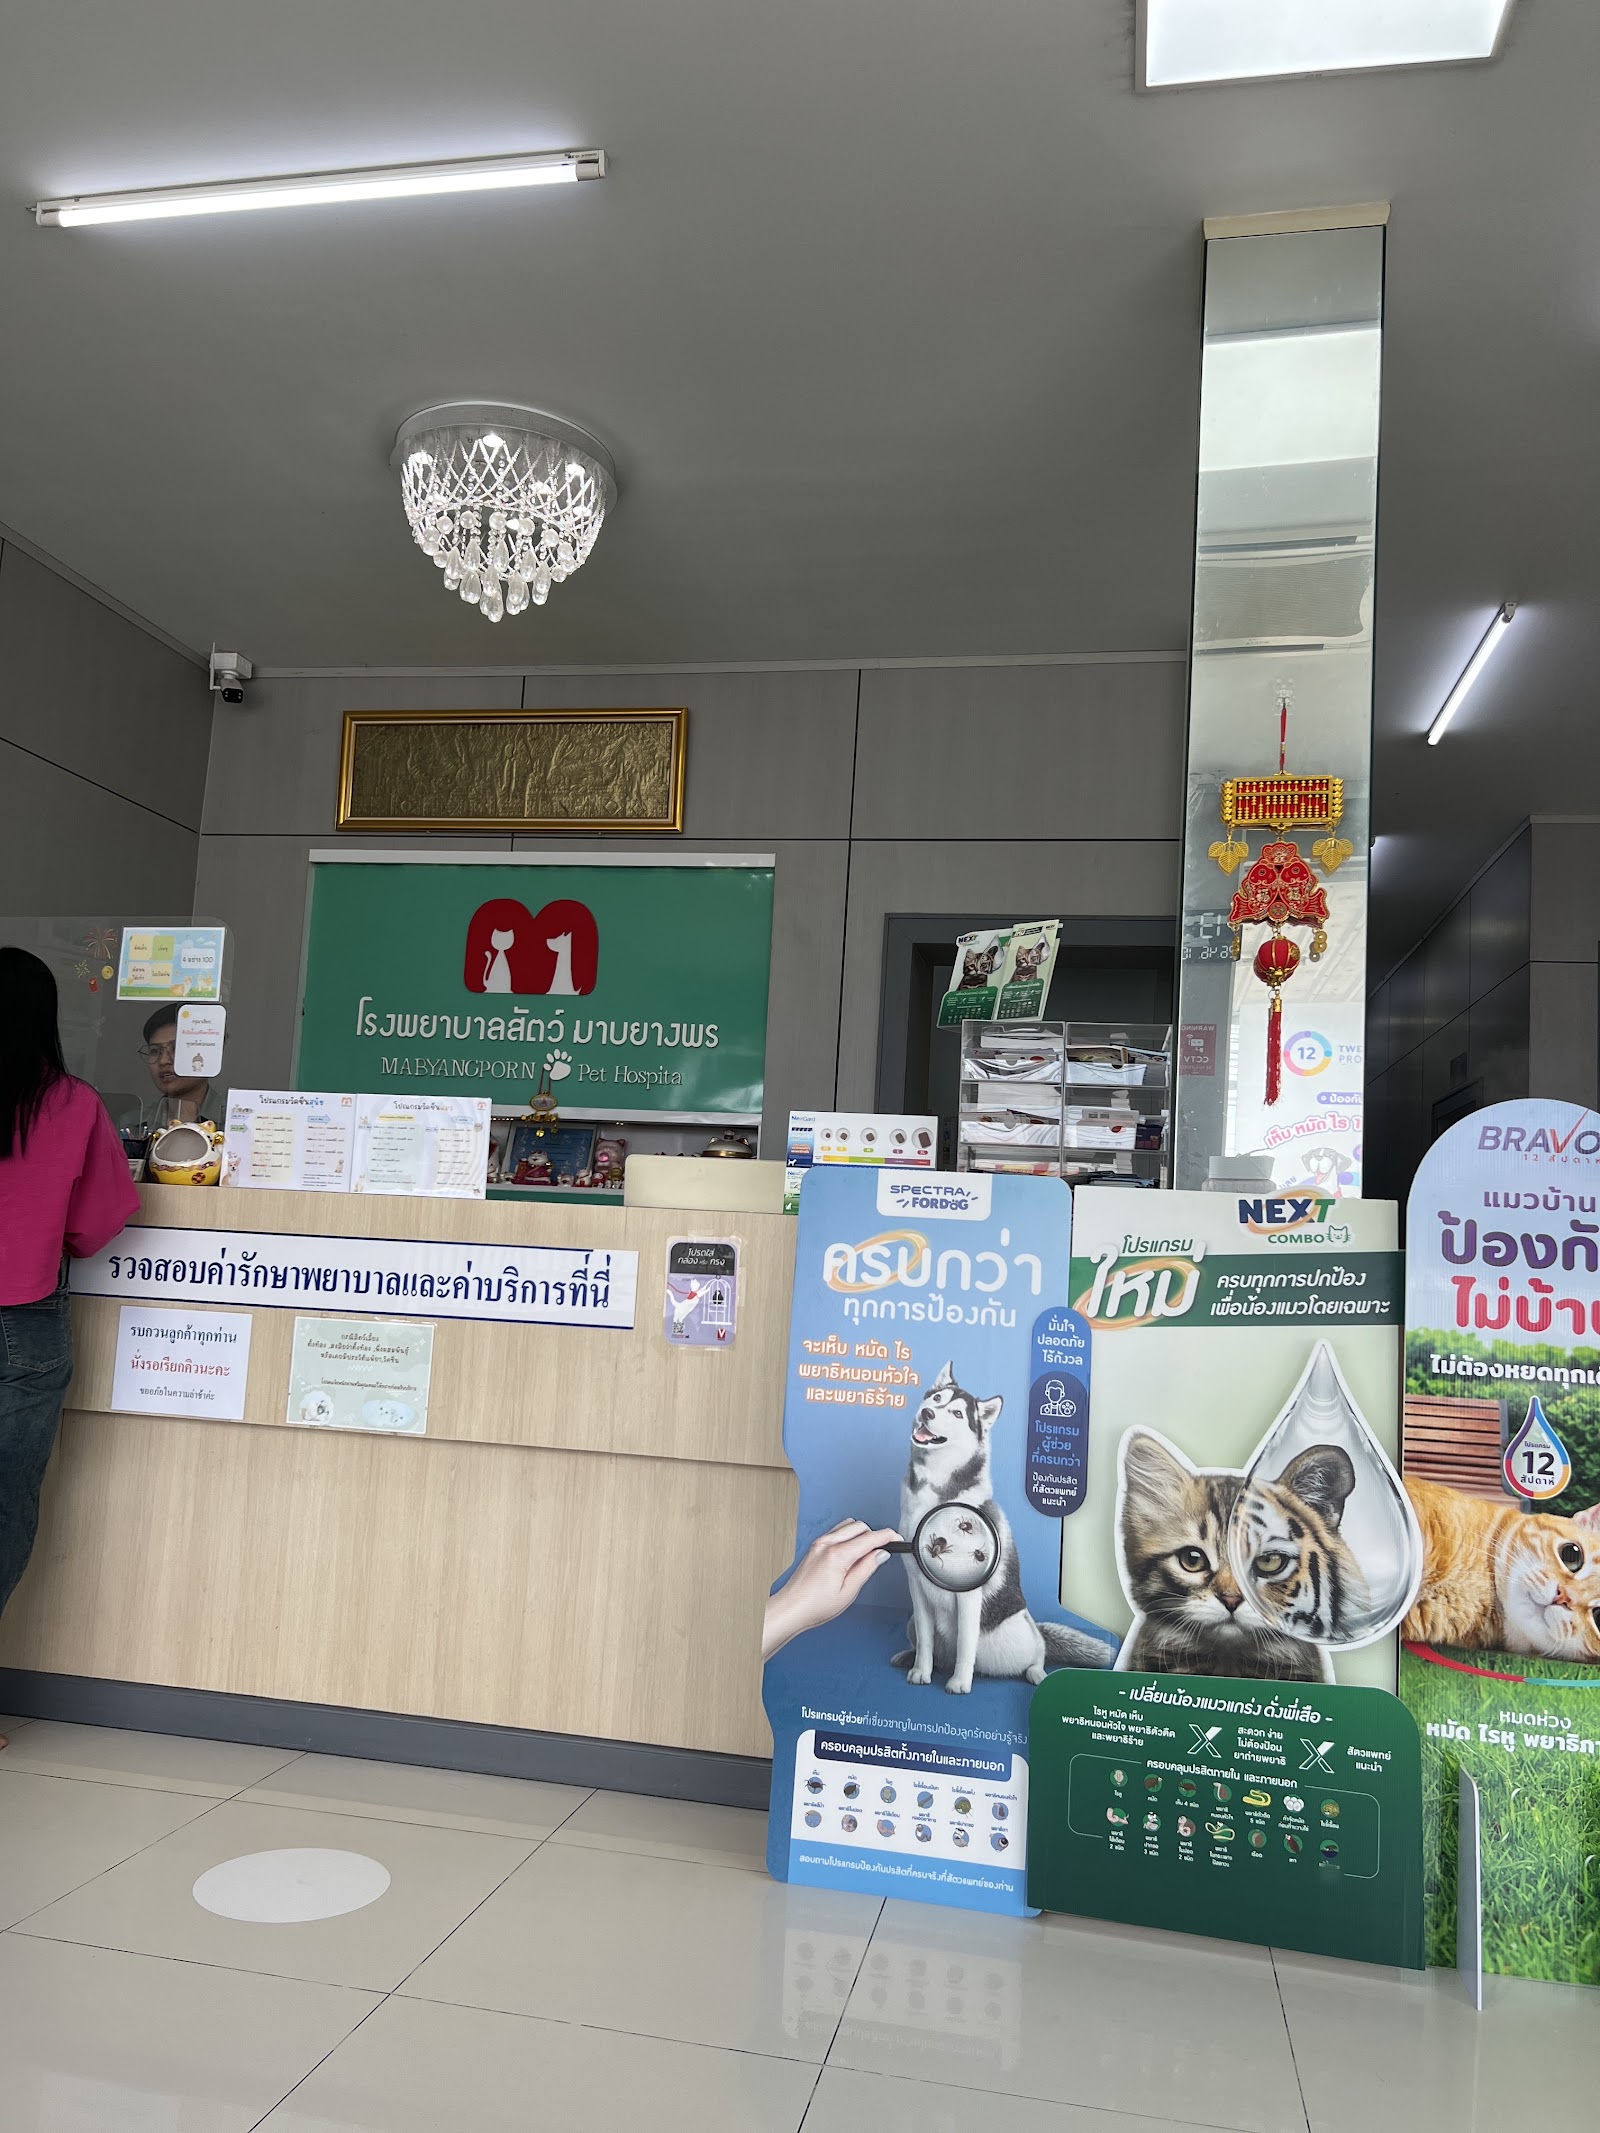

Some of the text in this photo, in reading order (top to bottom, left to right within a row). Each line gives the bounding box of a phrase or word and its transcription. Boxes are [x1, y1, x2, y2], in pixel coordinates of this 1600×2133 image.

[356, 996, 719, 1049] โรงพยาบาลสัตว์ มาบยางพร
[1297, 1046, 1316, 1060] 12
[380, 1056, 682, 1090] MABYANGPORN Pet Hospita
[1266, 1127, 1292, 1147] เห็บ
[1295, 1117, 1327, 1136] หมัด
[1328, 1113, 1347, 1129] ไร
[1523, 1153, 1539, 1162] 12
[890, 1184, 965, 1197] SPECTRA
[1483, 1186, 1596, 1213] แมวบ้าน
[1238, 1198, 1336, 1224] NEXT
[1121, 1234, 1194, 1255] โปรแกรม
[1267, 1233, 1325, 1245] COMBO
[822, 1228, 1042, 1296] ครบกว่า
[1086, 1240, 1207, 1318] ใหม่
[1216, 1266, 1367, 1293] ครบทุกการปกป้อง
[843, 1292, 1017, 1328] ทุกการป้องกัน
[1210, 1289, 1391, 1317] เพื่อน้องแมวโดยเฉพาะ
[1451, 1275, 1600, 1335] ไม่บ้า
[1048, 1313, 1075, 1332] มั่นใจ
[130, 1324, 237, 1346] รบกวนลูกค้าทุกท่าน
[1037, 1333, 1085, 1348] ปลอดภัย
[802, 1334, 911, 1360] จะเห็บ หมัด ไร
[1042, 1349, 1083, 1366] ไร้กังวล
[130, 1349, 231, 1376] นั่งรอเรียกคิวนะคะ
[798, 1362, 919, 1385] พยาธิหนอนหัวใจ
[806, 1386, 905, 1407] และพยาธิร้าย
[1035, 1419, 1079, 1437] โปรแกรม
[1042, 1435, 1072, 1453] ผู้ช่วย
[1524, 1440, 1550, 1449] โปรแกรม
[1031, 1448, 1081, 1468] ที่ครบกว่า
[1522, 1451, 1555, 1476] 12
[1032, 1471, 1078, 1485] ป้องกันปรสิต
[1520, 1474, 1555, 1486] สัปดาห์
[1032, 1481, 1078, 1497] ที่สัตวแพทย์
[1042, 1495, 1067, 1507] แนะนำ
[1129, 1680, 1321, 1724] เปลี่ยนน้องแมวแกร่ง ดั่งพี่เสือ
[1092, 1705, 1144, 1721] ไรหู หมัด เห็บ
[1499, 1709, 1572, 1729] หมดห่วง
[801, 1706, 1028, 1745] โปรแกรมผู้ช่วยที่เชี่ยวชาญในการปกป้องลูกรักอย่างรู้จริง
[1061, 1715, 1176, 1738] พยาธิหนอนหัวใจ พยาธิตัวตืด
[1237, 1726, 1283, 1740] สะดวก ง่าย
[1426, 1718, 1471, 1741] หมัด
[1478, 1723, 1515, 1753] ไรหู
[1091, 1732, 1144, 1746] และพยาธิร้าย
[1237, 1737, 1283, 1752] ไม่ต้องป้อน
[820, 1740, 1005, 1772] ครอบคลุมปรสิตทั้งภายในและภายนอก
[1233, 1750, 1287, 1766] ยาถ่ายพยาธิ
[1346, 1745, 1392, 1761] สัตวแพทย์
[1146, 1759, 1298, 1788] ครอบคลุมปรสิตภายใน และภายนอก
[1355, 1760, 1383, 1773] แนะนำ
[799, 1854, 1014, 1892] สอบถามโปรแกรมป้องกันปรสิตที่ครบจริงที่สัตวแพทย์ของท่าน
